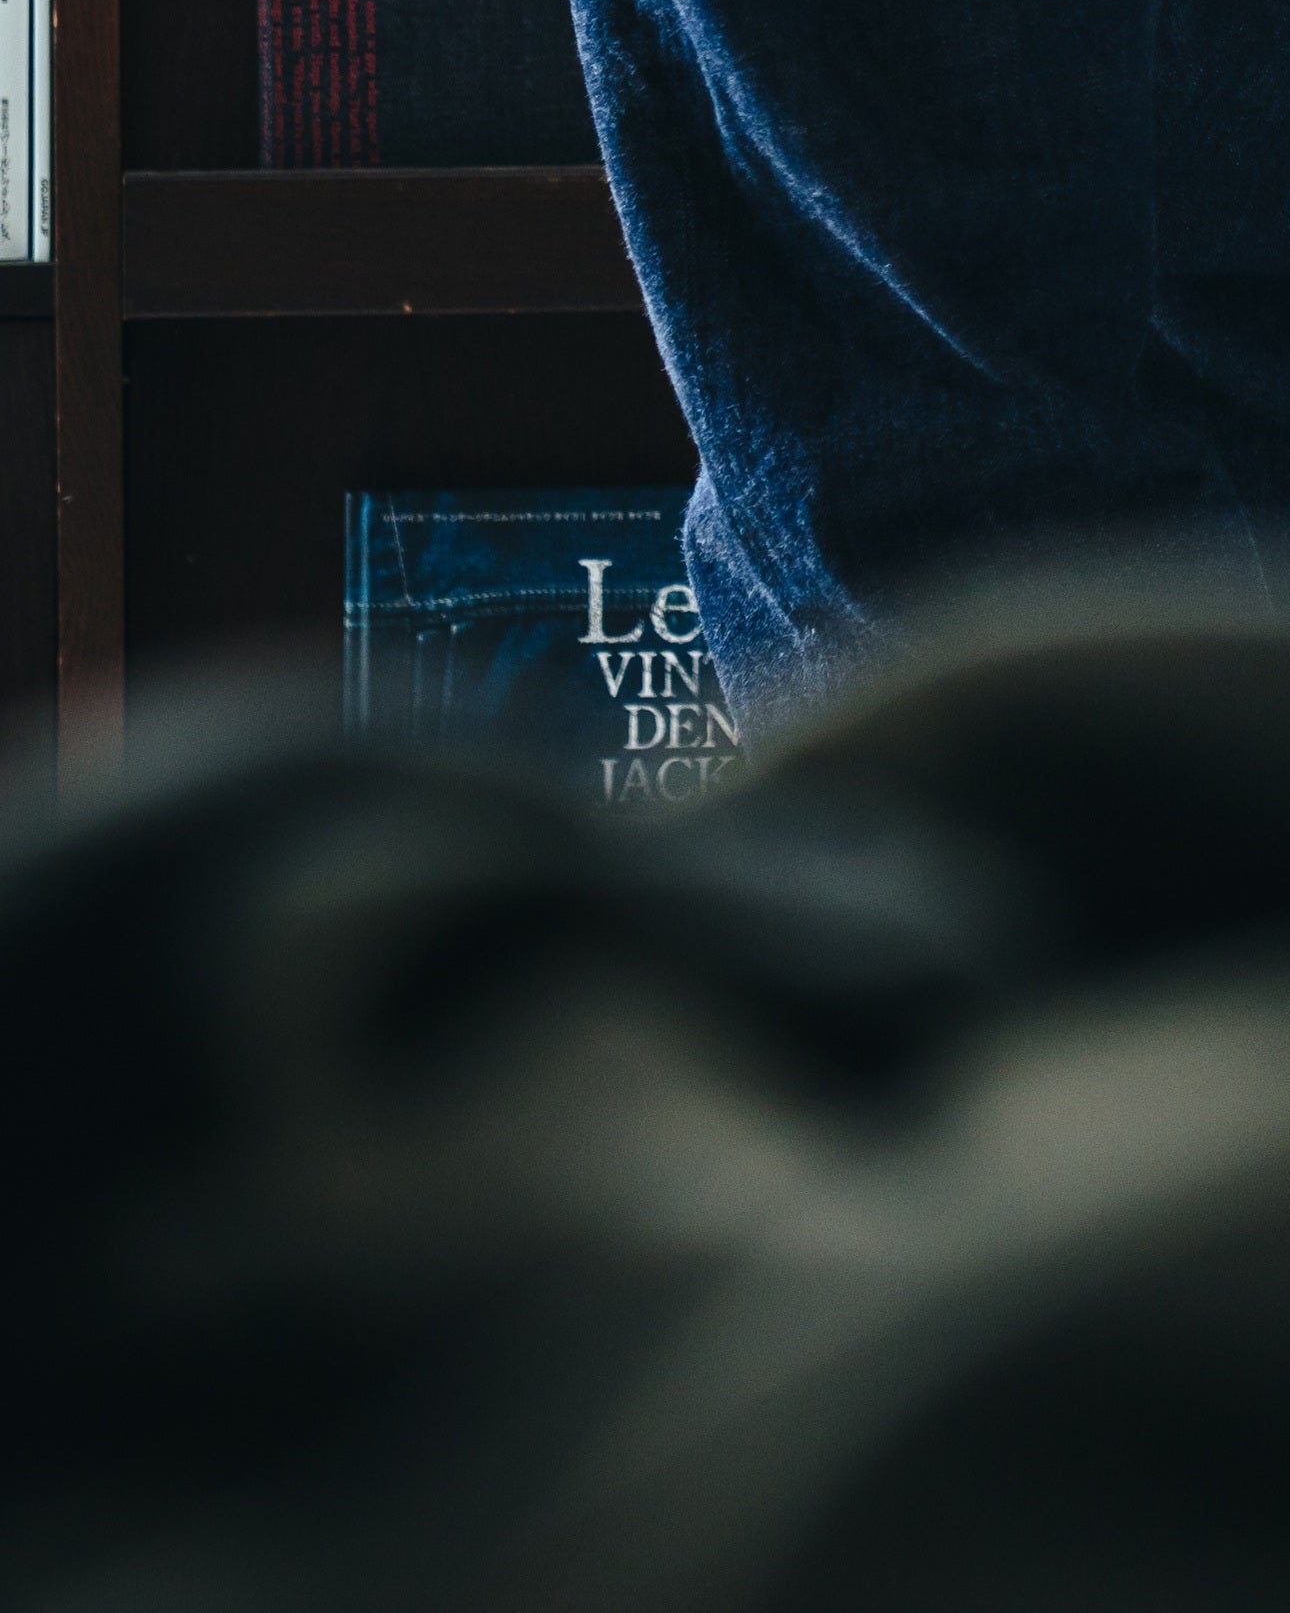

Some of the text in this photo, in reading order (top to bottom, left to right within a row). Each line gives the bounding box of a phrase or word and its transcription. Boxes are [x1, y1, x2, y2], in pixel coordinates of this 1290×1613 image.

[577, 558, 701, 644] Le
[595, 650, 714, 699] VIN
[622, 703, 740, 751] DEN
[600, 754, 738, 804] JACK
